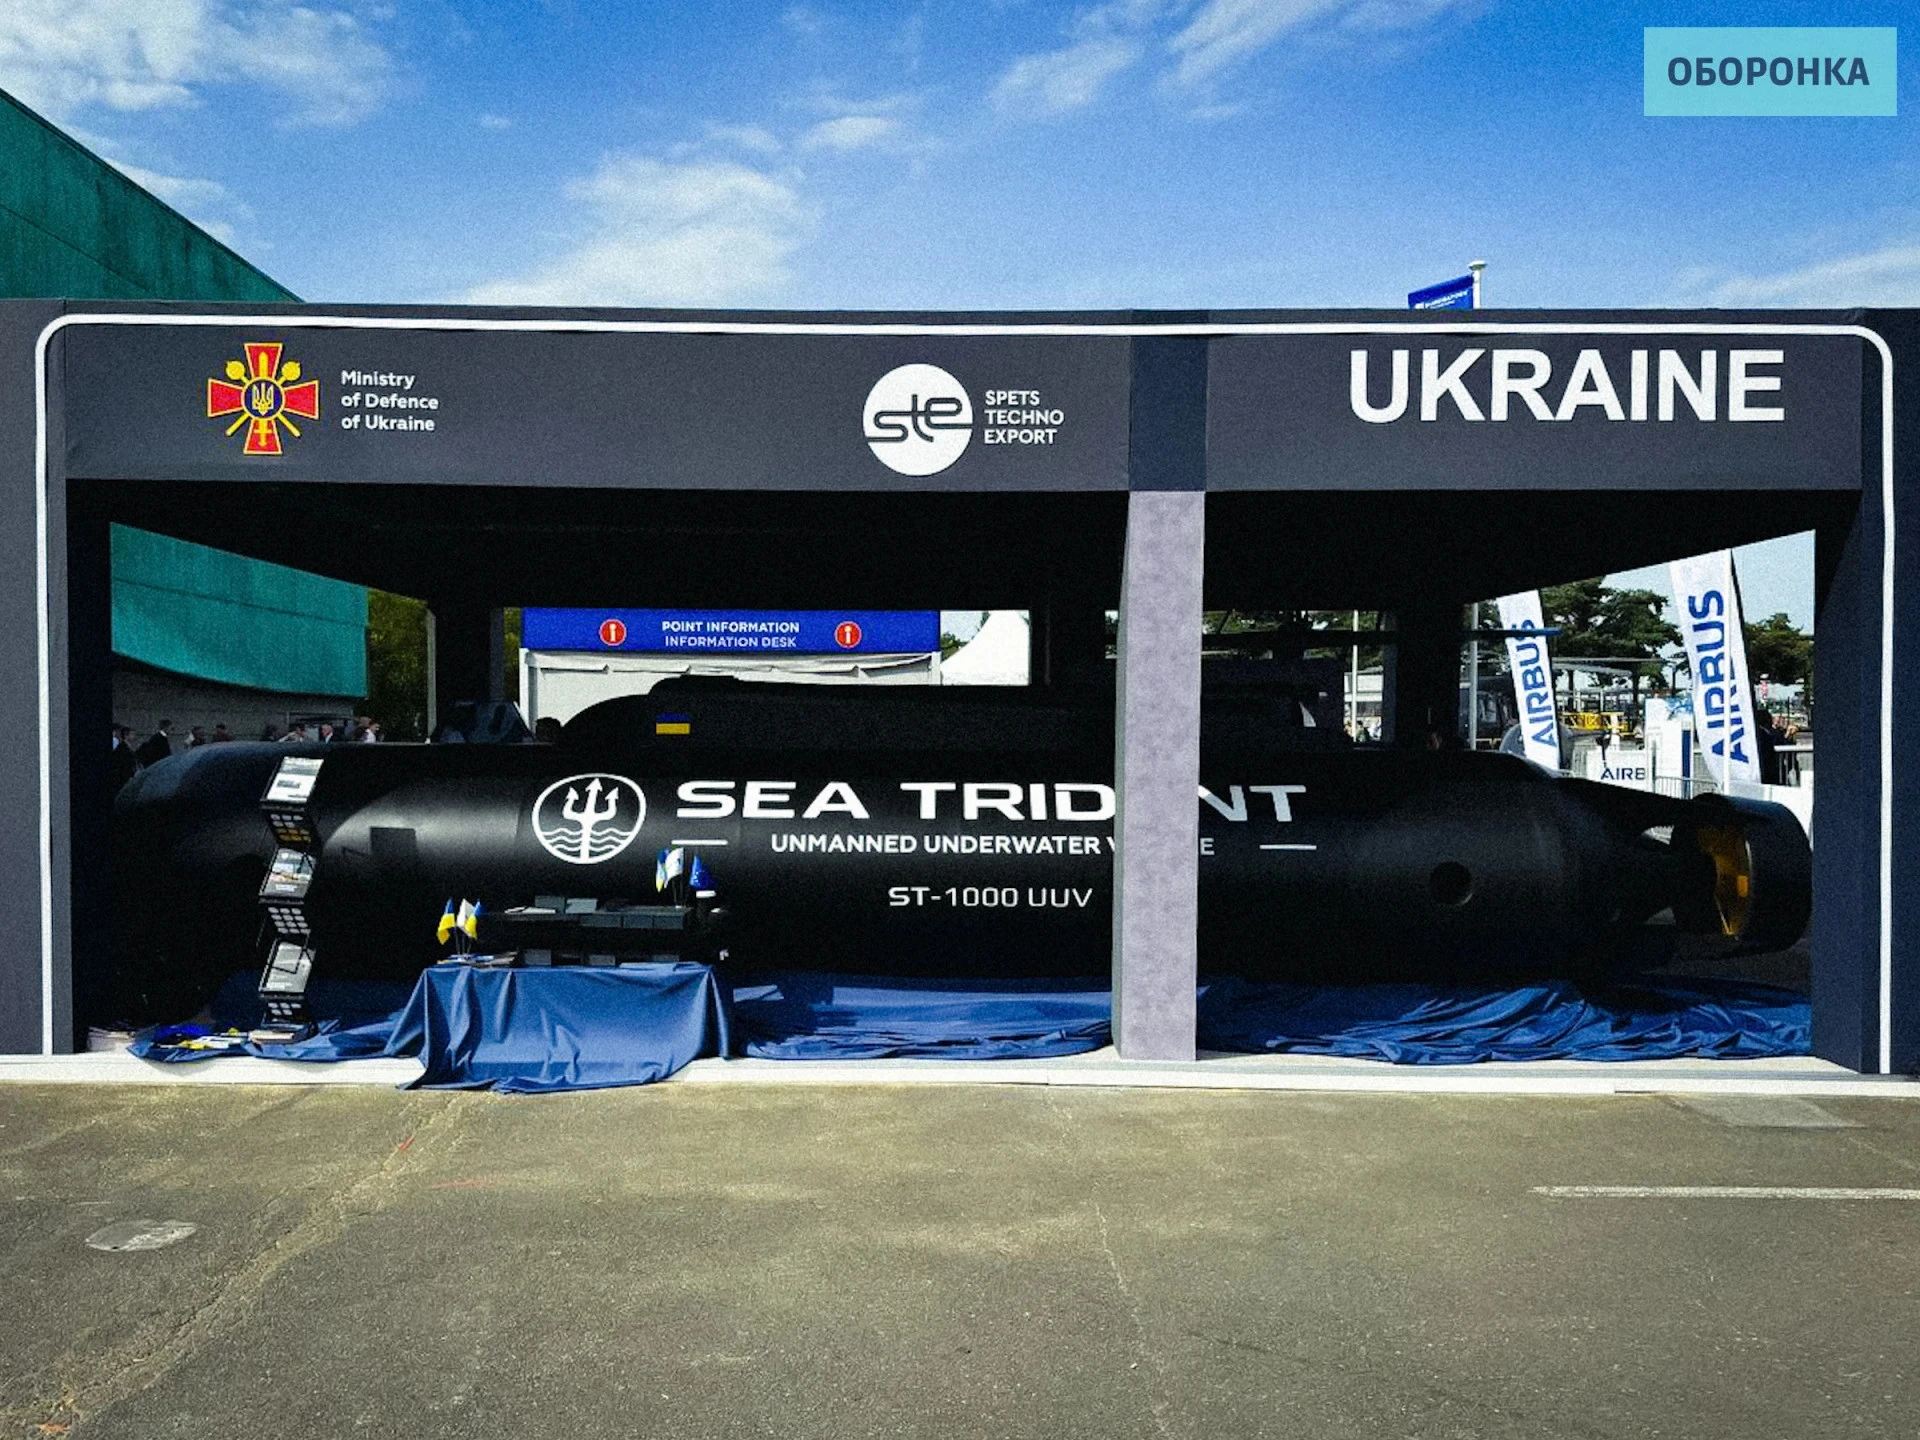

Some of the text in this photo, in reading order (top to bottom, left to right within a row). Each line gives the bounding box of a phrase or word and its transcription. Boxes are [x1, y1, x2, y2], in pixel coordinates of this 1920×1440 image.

[341, 370, 416, 389] Ministry
[1350, 348, 1785, 424] UKRAINE
[341, 392, 439, 409] of Defence
[985, 390, 1040, 406] SPETS
[341, 414, 435, 431] of Ukraine
[984, 409, 1065, 425] TECHNO
[984, 428, 1058, 444] EXPORT
[662, 621, 800, 633] POINT INFORMATION
[665, 636, 797, 648] INFORMATION DESK
[677, 780, 1307, 822] SEA TRIDNT
[771, 833, 918, 854] UNMANNED
[923, 835, 1101, 855] UNDERWATER
[888, 886, 1093, 908] ST-1000 UUV
